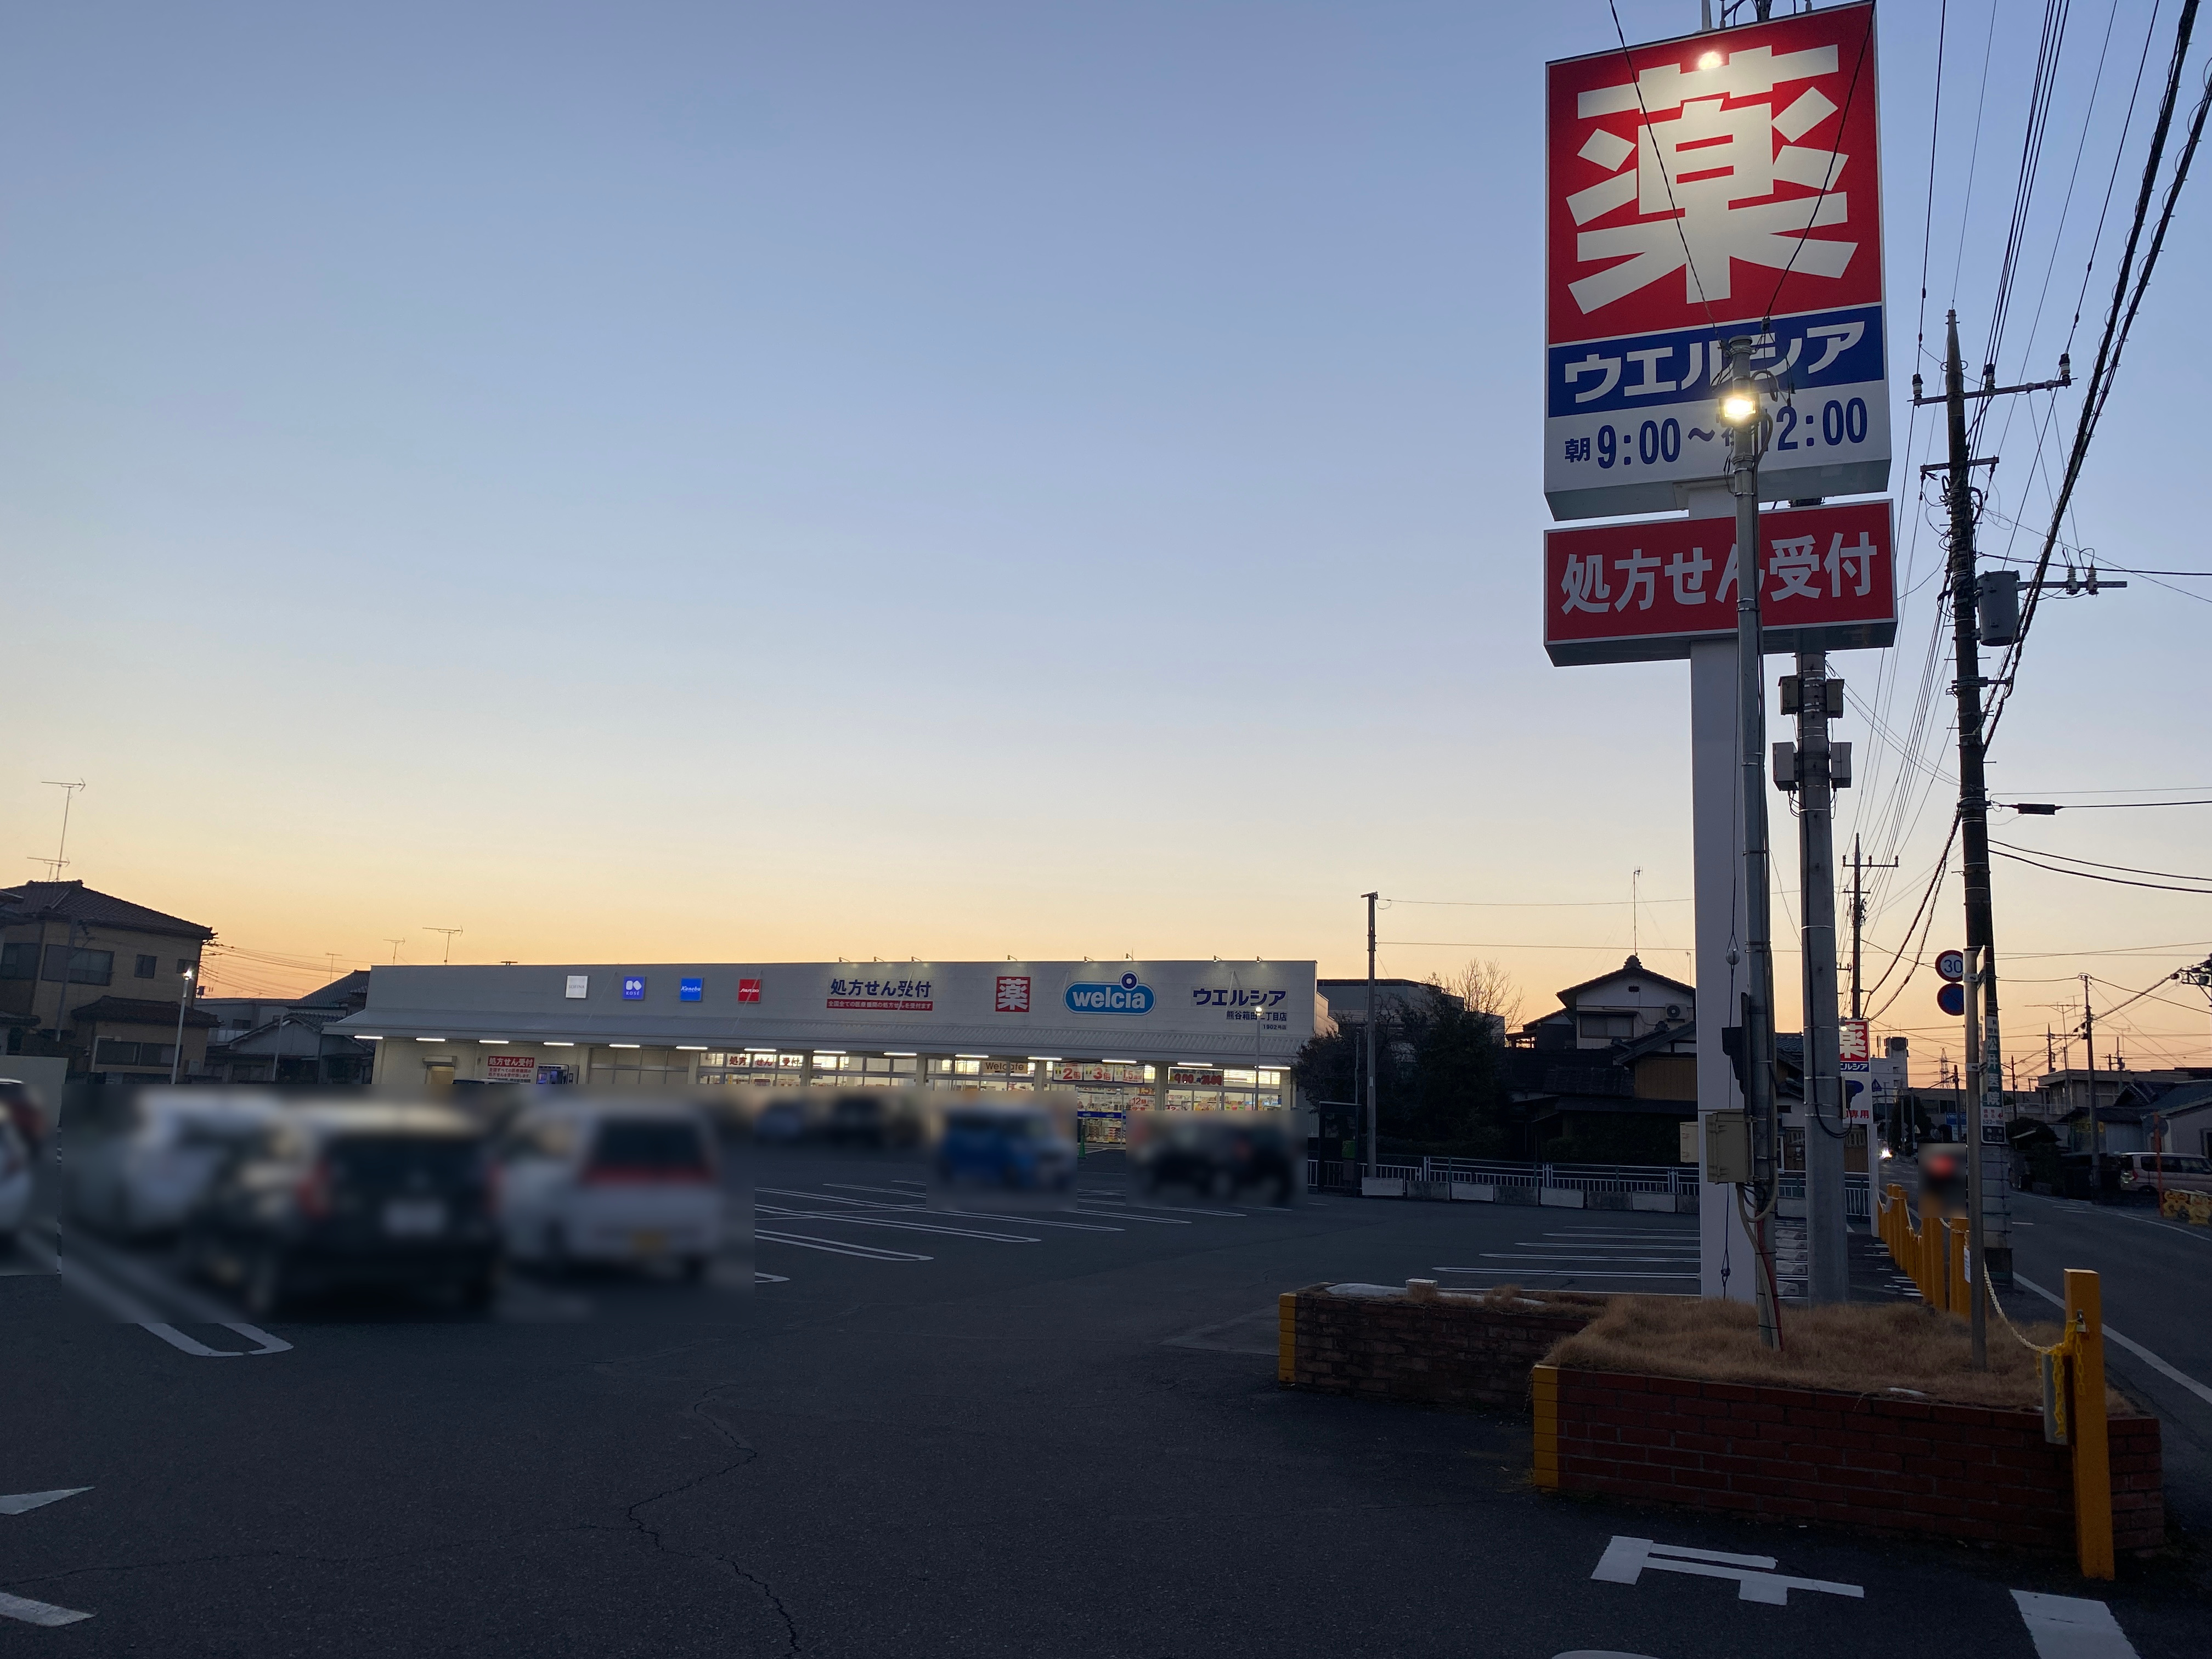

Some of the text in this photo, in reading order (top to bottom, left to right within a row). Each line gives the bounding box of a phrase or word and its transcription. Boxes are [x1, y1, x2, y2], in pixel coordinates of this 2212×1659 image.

[1566, 45, 1858, 314] 薬
[1565, 321, 1865, 403] ウエルシア
[1565, 398, 1867, 469] 朝9:00～12:00
[1561, 532, 1877, 615] 処方せん受付
[1944, 960, 1962, 973] 30
[831, 978, 932, 997] 処方せん受付
[997, 979, 1028, 1010] 薬
[1073, 973, 1146, 1009] welcia
[1193, 989, 1286, 1007] ウエルシア
[1839, 1023, 1867, 1058] 薬
[488, 1057, 533, 1067] 処方せん受付
[1846, 1110, 1869, 1119] 専用
